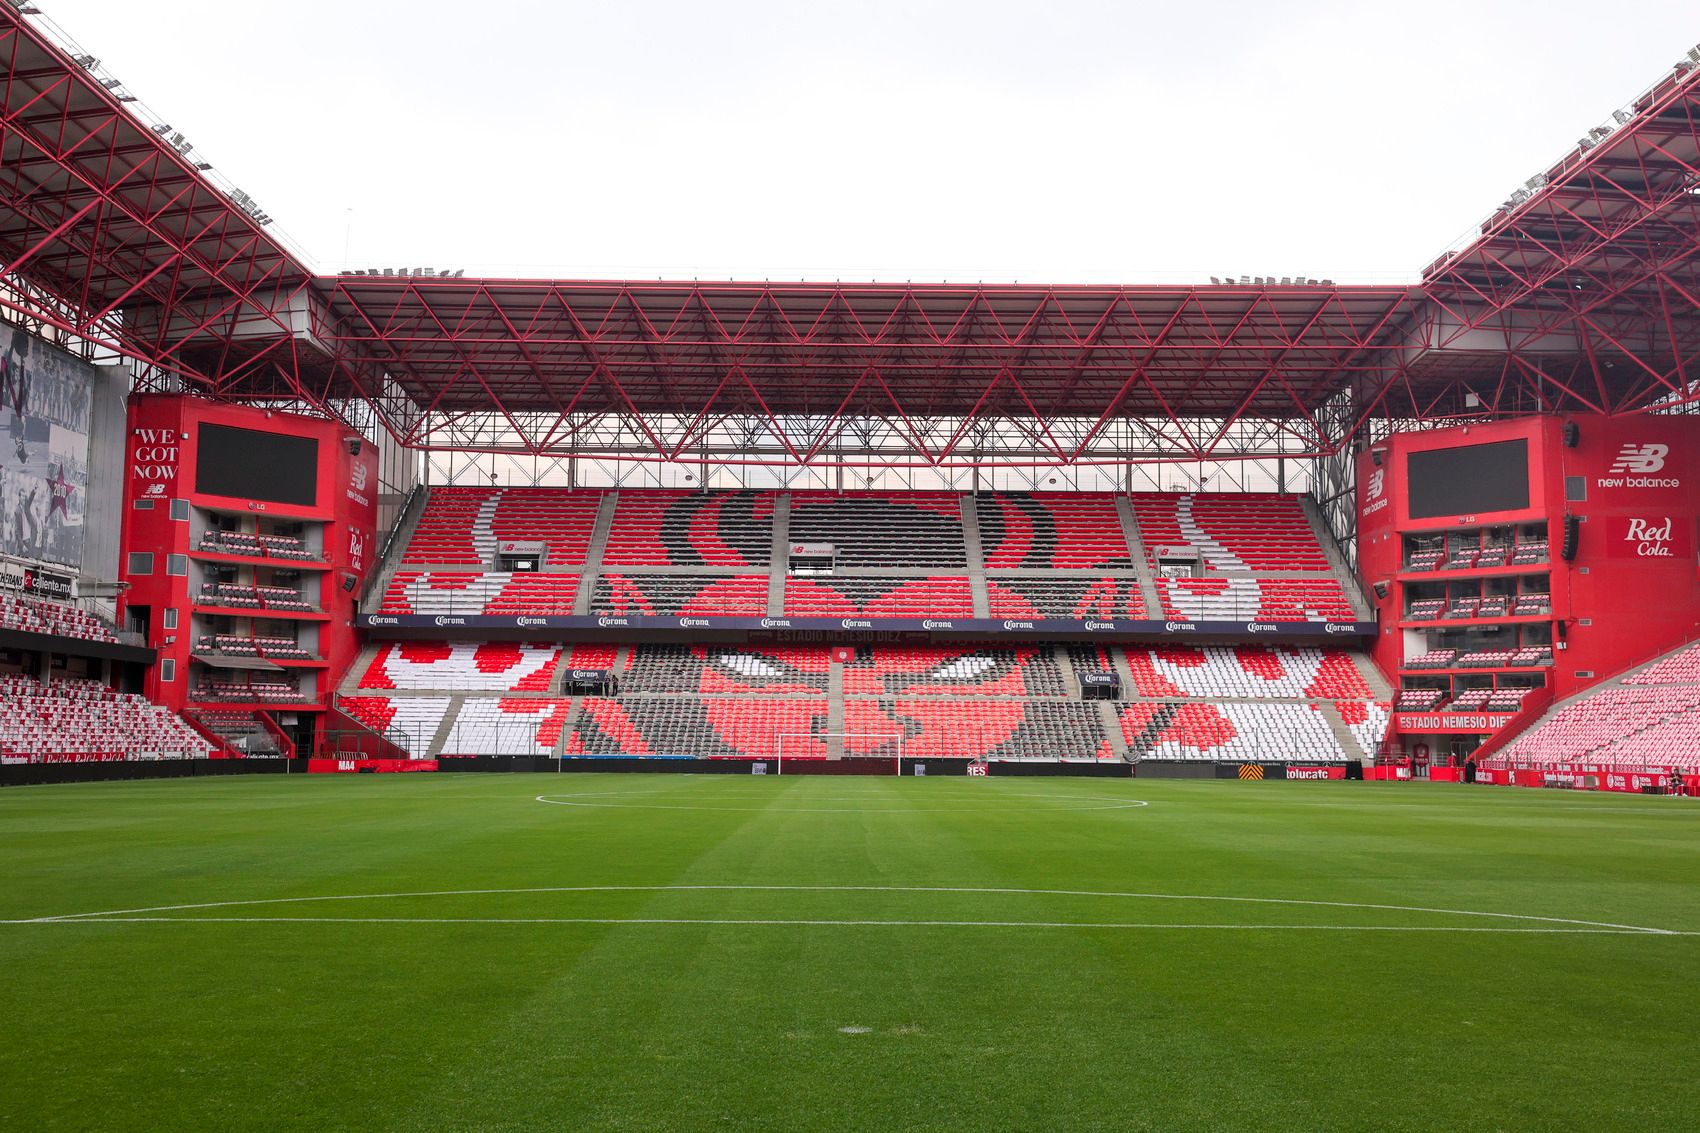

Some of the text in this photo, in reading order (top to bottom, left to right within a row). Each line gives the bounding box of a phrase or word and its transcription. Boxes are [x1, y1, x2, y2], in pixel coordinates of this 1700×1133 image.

[139, 429, 175, 444] WE
[135, 446, 179, 462] GOT
[133, 465, 179, 480] NOW
[1597, 476, 1680, 488] new balance
[1465, 515, 1475, 523] LG
[1624, 517, 1674, 541] Red
[1637, 541, 1674, 556] Cola
[32, 577, 71, 594] caliente.mx
[368, 614, 399, 626] Corona
[435, 615, 466, 626] Corona
[516, 616, 547, 627] Corona
[598, 617, 628, 628] Corona
[679, 617, 710, 628] Corona
[760, 618, 791, 628] Corona
[841, 618, 872, 629] Corona
[922, 619, 953, 630] Corona
[1003, 619, 1034, 630] Corona
[1085, 620, 1115, 631] Corona
[1165, 621, 1196, 632] Corona
[1247, 622, 1278, 633] Corona
[1325, 623, 1355, 634] Corona
[1085, 674, 1112, 684] Corona
[1400, 716, 1512, 729] ESTADIO NEMESIO DIE
[338, 760, 355, 771] MA4
